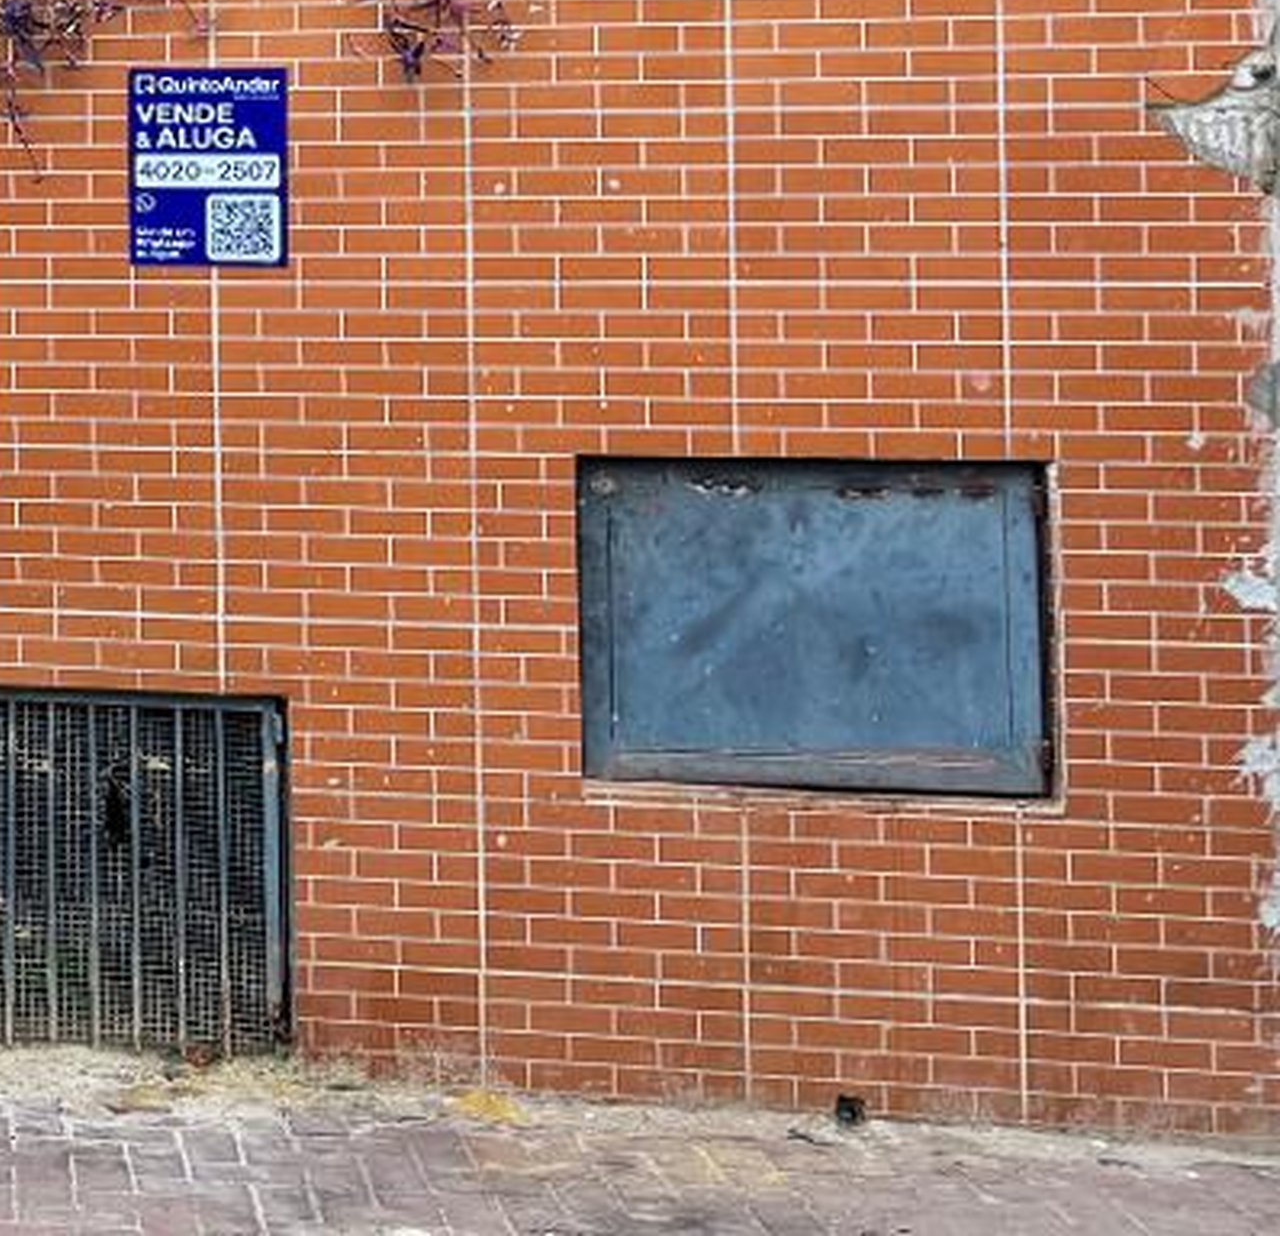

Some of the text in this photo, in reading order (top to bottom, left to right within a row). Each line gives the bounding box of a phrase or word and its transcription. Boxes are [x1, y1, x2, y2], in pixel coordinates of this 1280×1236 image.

[158, 76, 280, 94] QuintoAndar
[136, 102, 235, 124] VENDE
[136, 127, 257, 150] & ALUGA
[139, 160, 277, 181] 4020-2507
